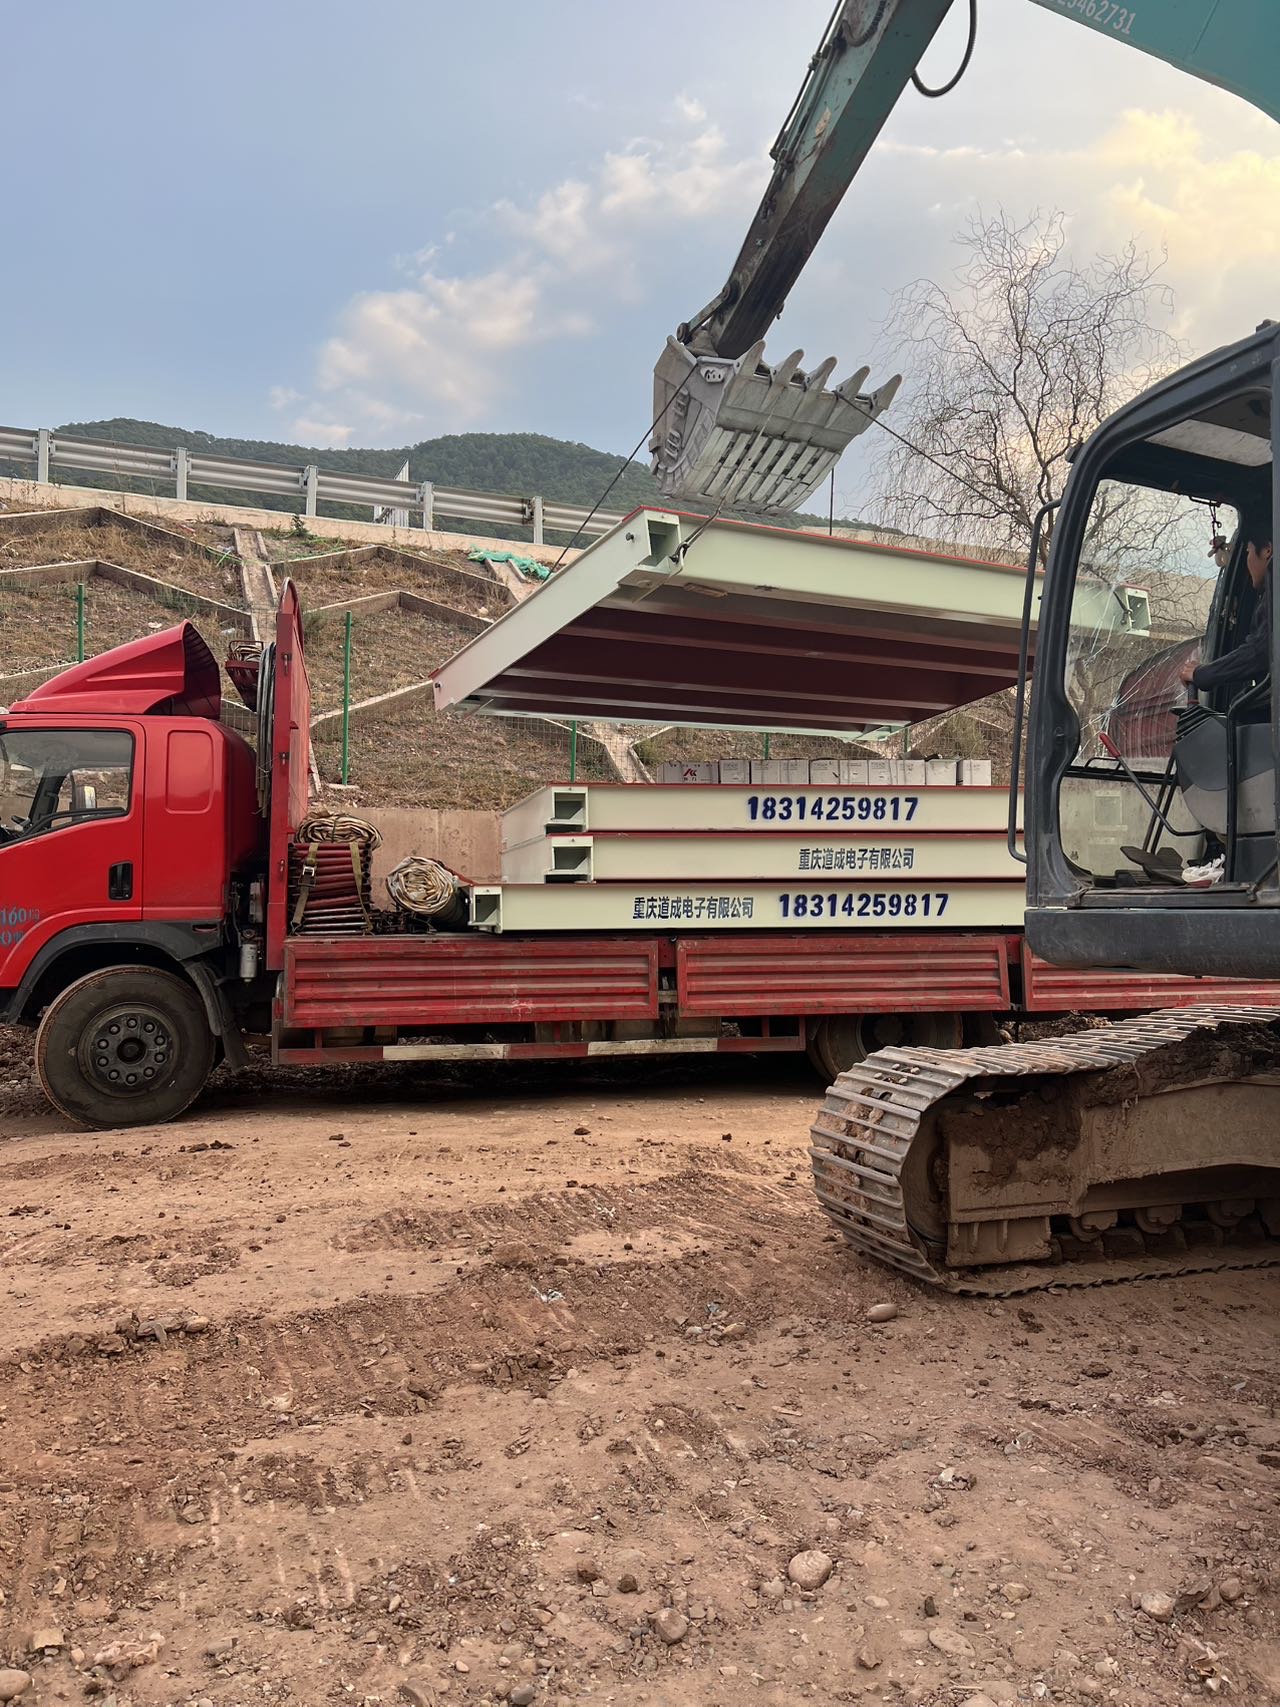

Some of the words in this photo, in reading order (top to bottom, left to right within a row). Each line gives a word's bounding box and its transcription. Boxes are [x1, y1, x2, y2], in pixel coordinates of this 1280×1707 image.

[747, 796, 919, 821] 18314259817
[798, 847, 915, 870] 重庆道成电子有限公司
[632, 896, 754, 920] 重庆道成电子有限公司
[779, 893, 949, 917] 18314259817
